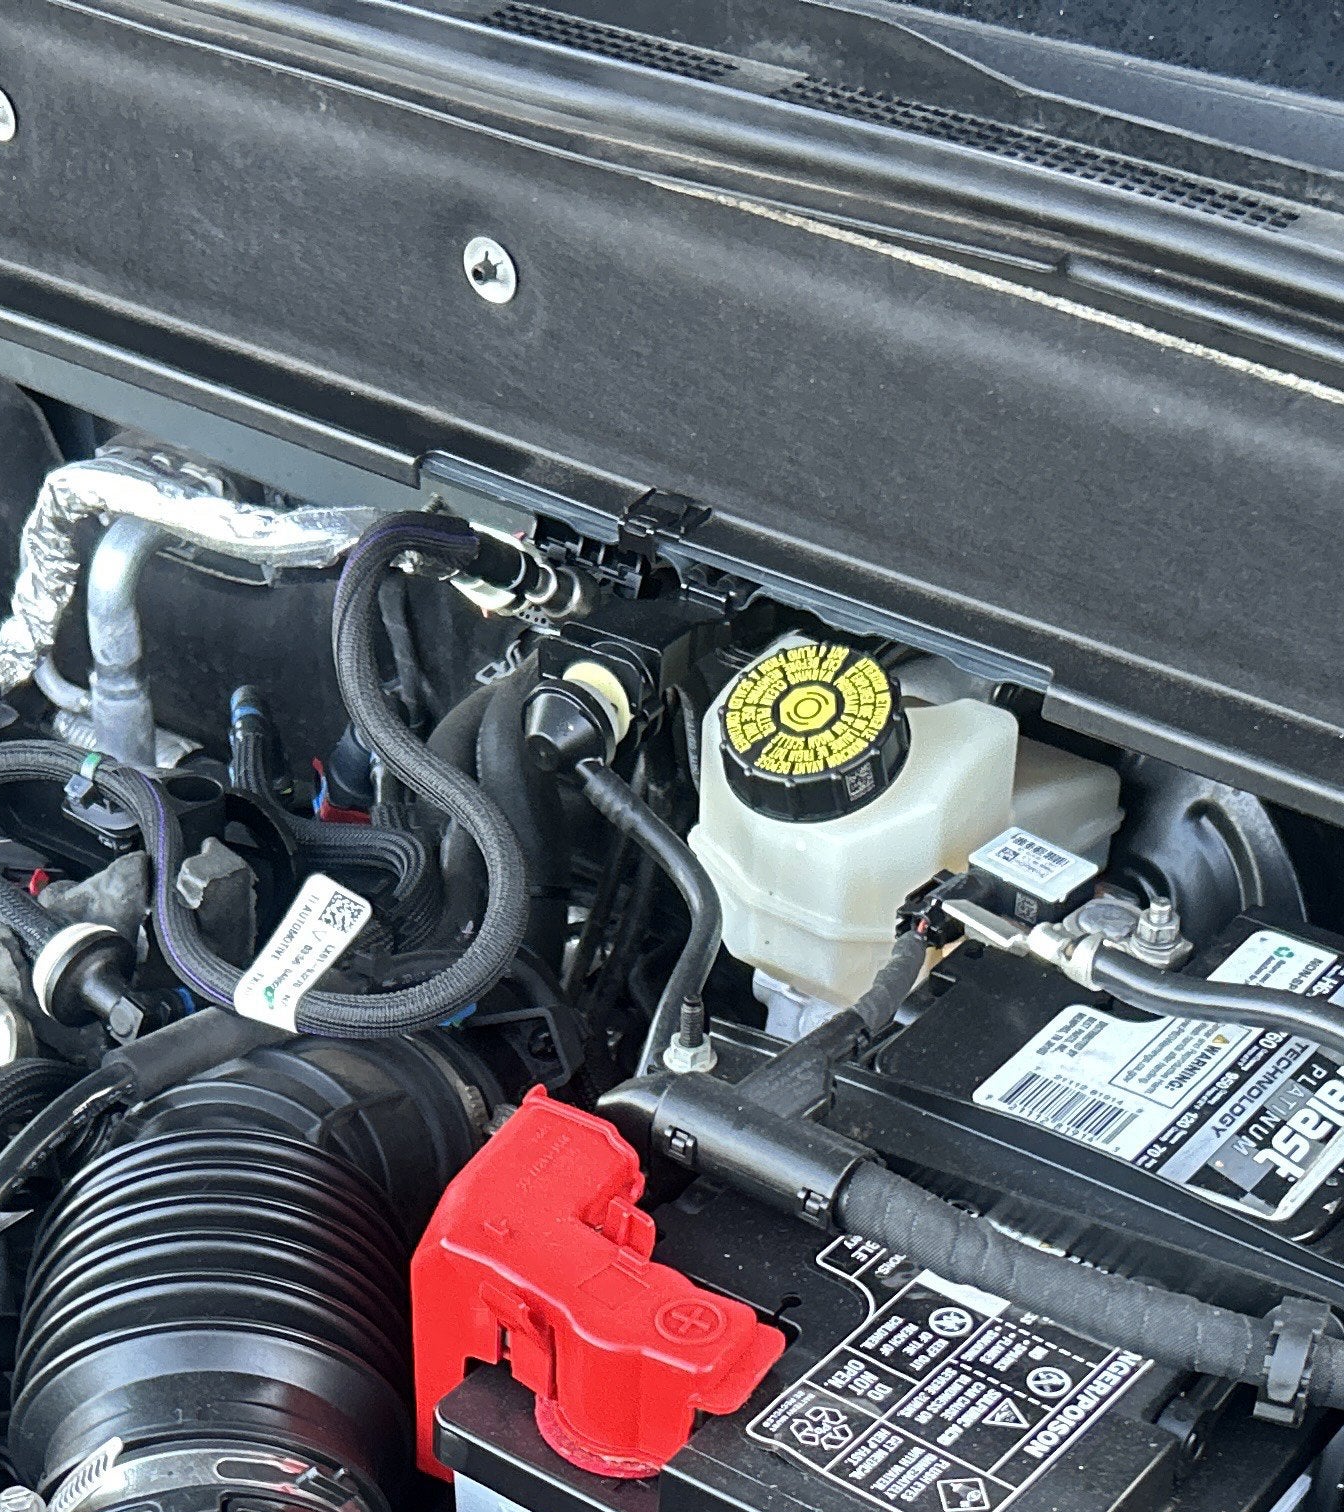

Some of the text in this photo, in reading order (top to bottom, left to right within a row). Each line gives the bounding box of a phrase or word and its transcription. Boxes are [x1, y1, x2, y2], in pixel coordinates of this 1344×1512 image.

[271, 905, 312, 960] AUTOMOTIVE
[1163, 1043, 1221, 1092] WARNING:
[1213, 1071, 1240, 1089] 950
[1205, 1041, 1309, 1138] TECHNOLOGY
[1174, 1110, 1201, 1128] 120
[1228, 1063, 1329, 1155] PLATINUM
[1145, 1143, 1167, 1158] 70
[858, 1314, 904, 1351] CHILDREN.
[876, 1321, 919, 1356] REACH OF
[901, 1330, 933, 1356] OF THE
[977, 1335, 1013, 1365] FLAMES
[908, 1337, 949, 1371] KEEP OUT
[992, 1342, 1028, 1371] SPARKS
[822, 1357, 865, 1392] OPEN.
[845, 1370, 879, 1396] NOT
[865, 1381, 893, 1402] DO
[922, 1366, 958, 1396] SEVERE
[912, 1373, 972, 1425] BLINDNESS OR
[938, 1380, 987, 1421] CAN CAUSE
[843, 1427, 891, 1467] HELP FAST.
[880, 1433, 904, 1452] GET
[934, 1423, 965, 1447] ACID
[868, 1444, 925, 1493] WITH WATER.
[881, 1451, 938, 1500] IMMEDIATELY
[899, 1458, 951, 1503] FLUSH EYES
